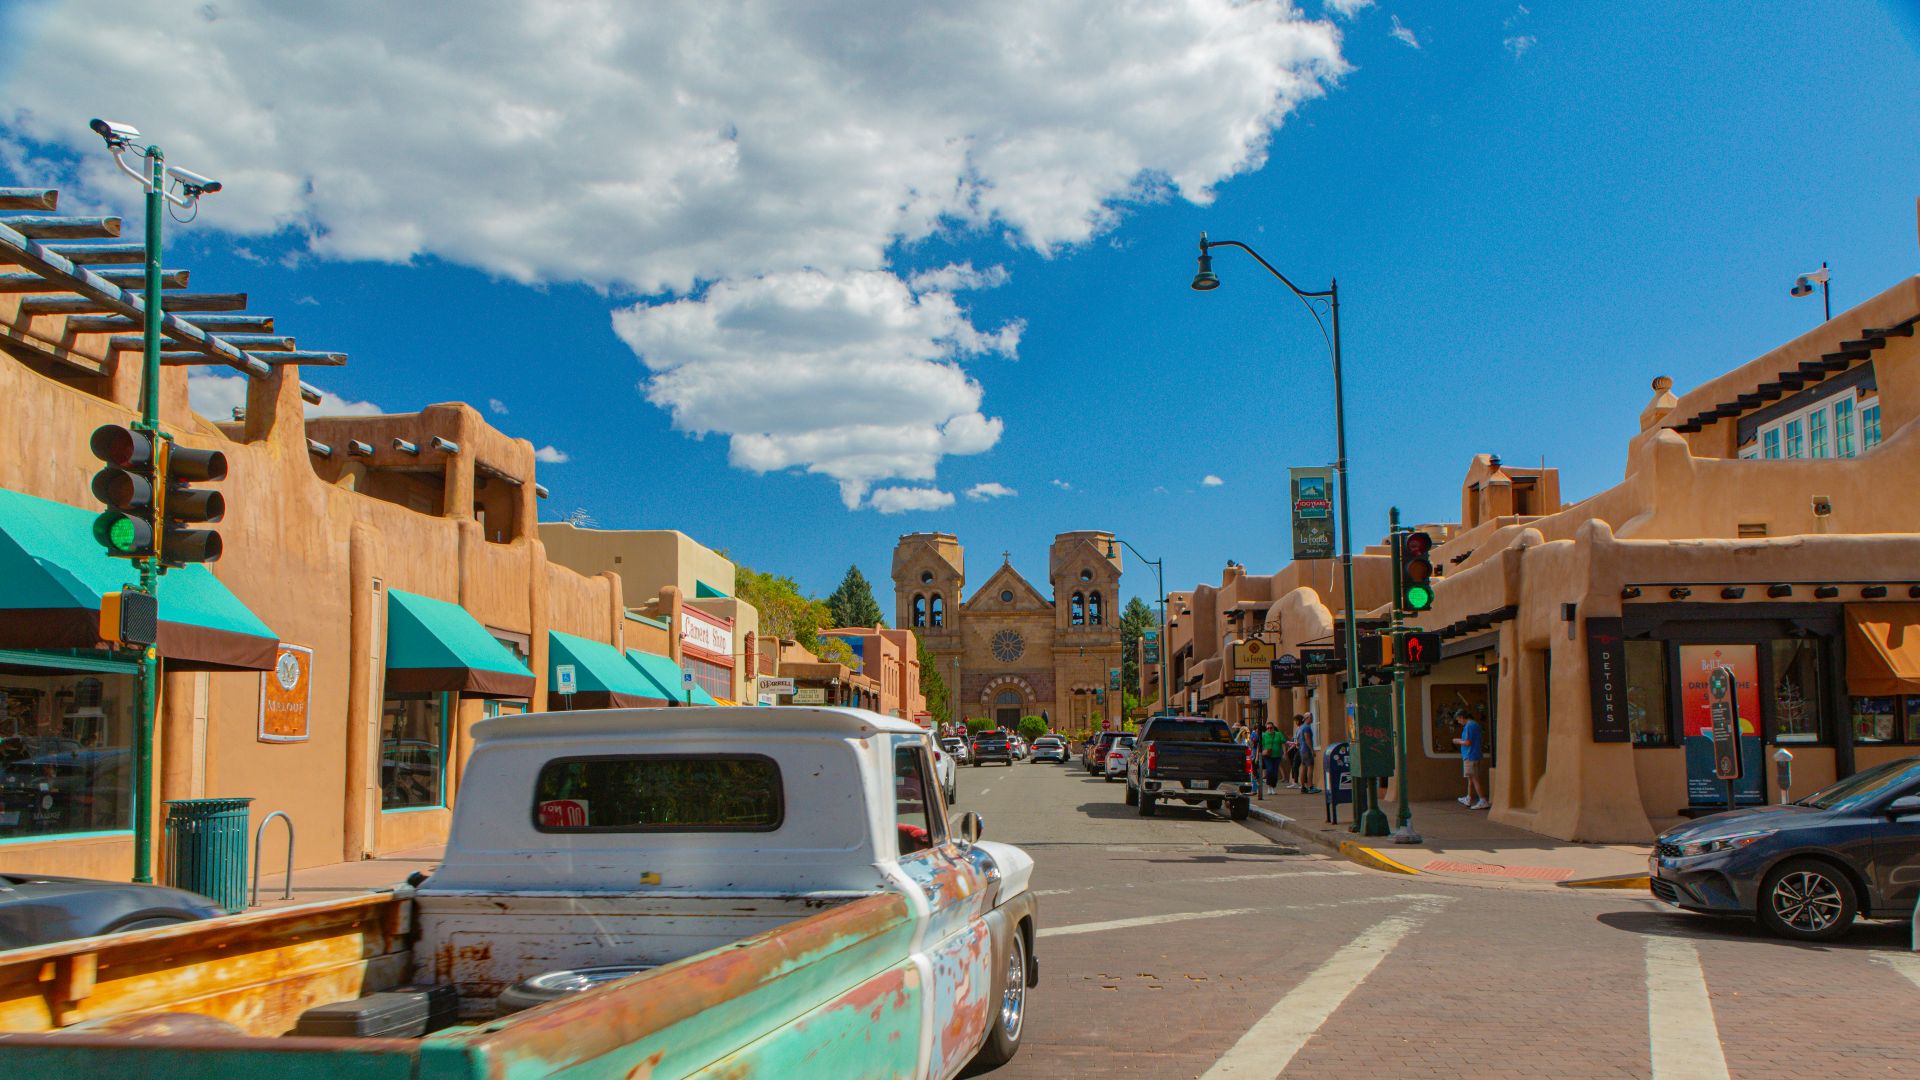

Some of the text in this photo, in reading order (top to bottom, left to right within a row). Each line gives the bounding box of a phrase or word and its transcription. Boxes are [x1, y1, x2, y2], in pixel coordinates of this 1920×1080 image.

[1300, 532, 1328, 545] La Fonda
[685, 616, 726, 654] Camera Shop
[1701, 659, 1714, 671] Bell
[1602, 652, 1614, 722] DETOURS
[267, 699, 304, 713] MALOUF
